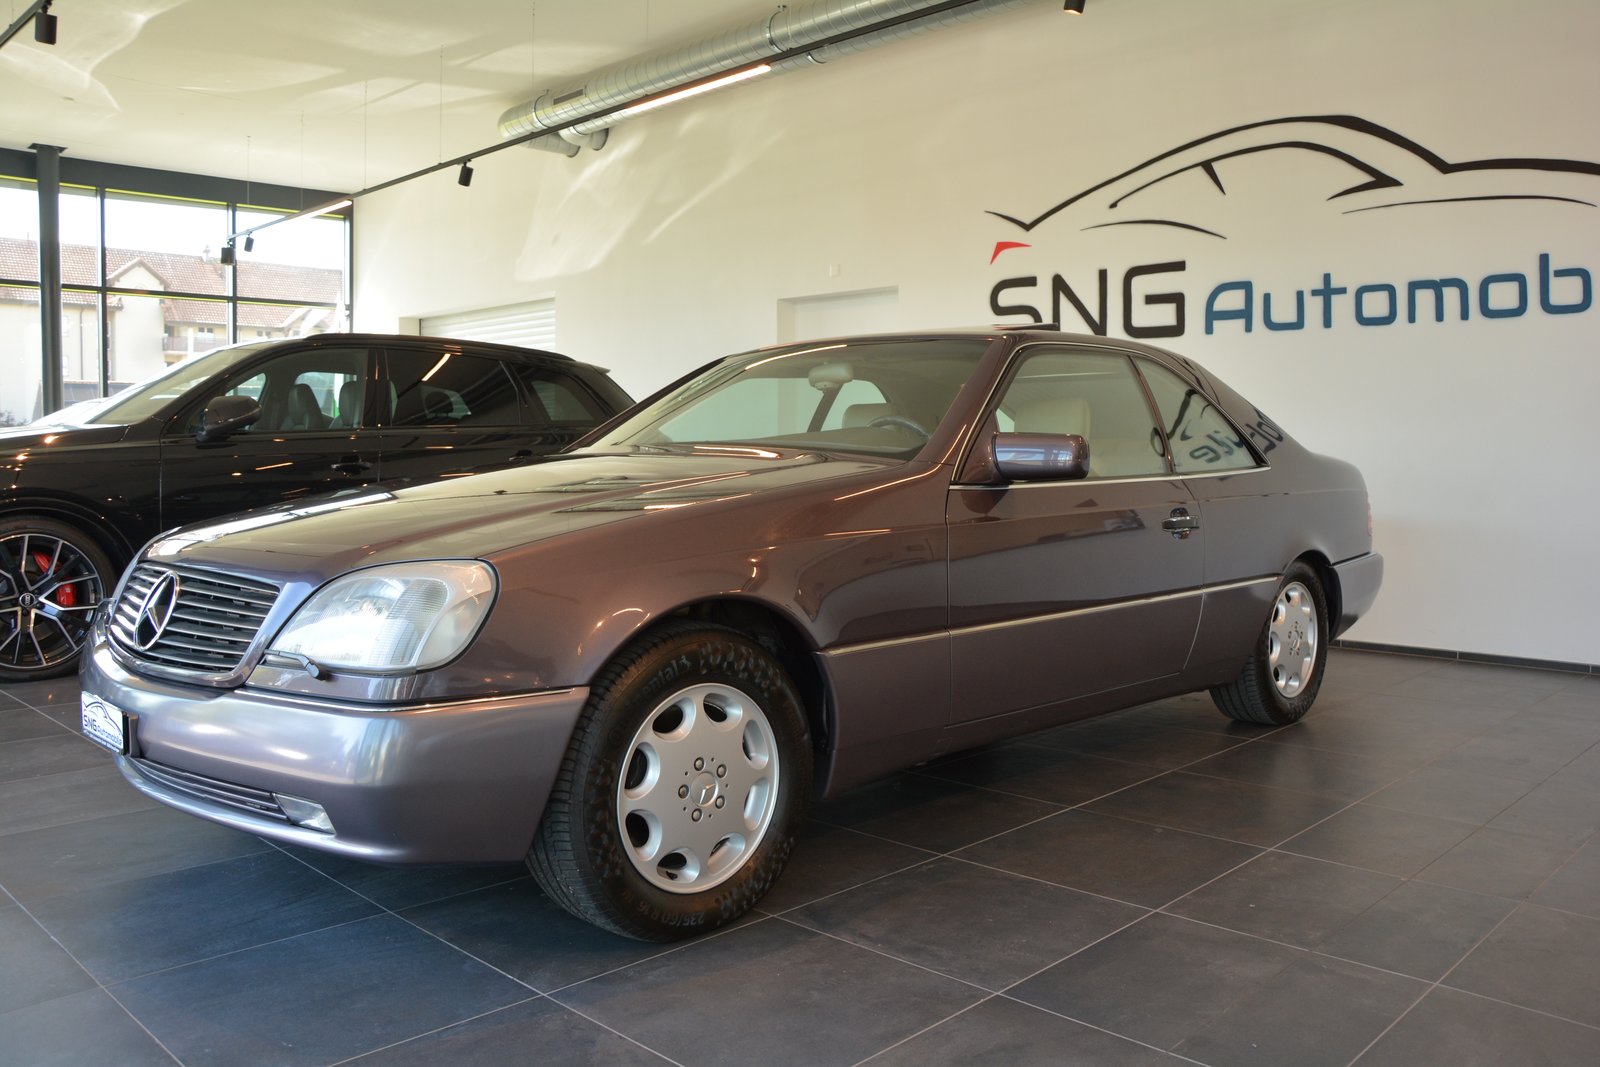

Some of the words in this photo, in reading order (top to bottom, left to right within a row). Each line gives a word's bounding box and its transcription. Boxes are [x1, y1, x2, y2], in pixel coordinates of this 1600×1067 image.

[989, 261, 1186, 338] SNG
[1204, 253, 1593, 336] Automob
[83, 714, 97, 732] SNG
